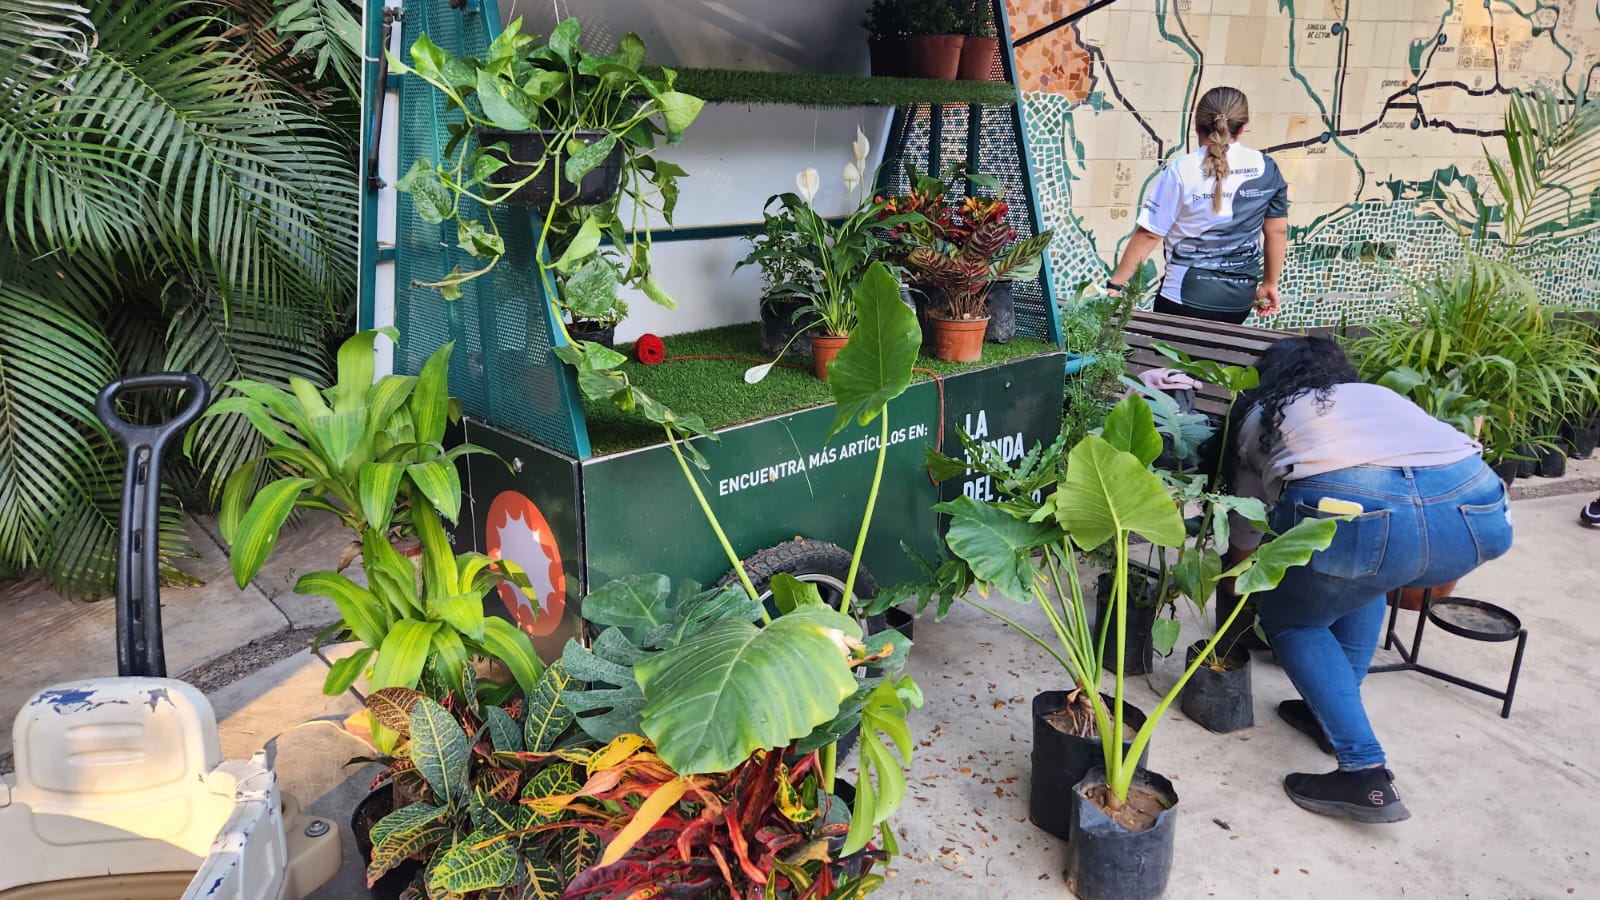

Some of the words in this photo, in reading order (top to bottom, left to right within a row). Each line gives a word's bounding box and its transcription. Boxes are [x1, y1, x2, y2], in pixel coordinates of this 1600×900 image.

[1311, 244, 1341, 261] Mar
[966, 410, 988, 441] LA
[719, 458, 805, 496] ENCUENTRA
[809, 446, 836, 470] MÁS
[909, 423, 928, 440] EN:
[964, 432, 1025, 476] TNDA
[963, 475, 994, 502] DEL
